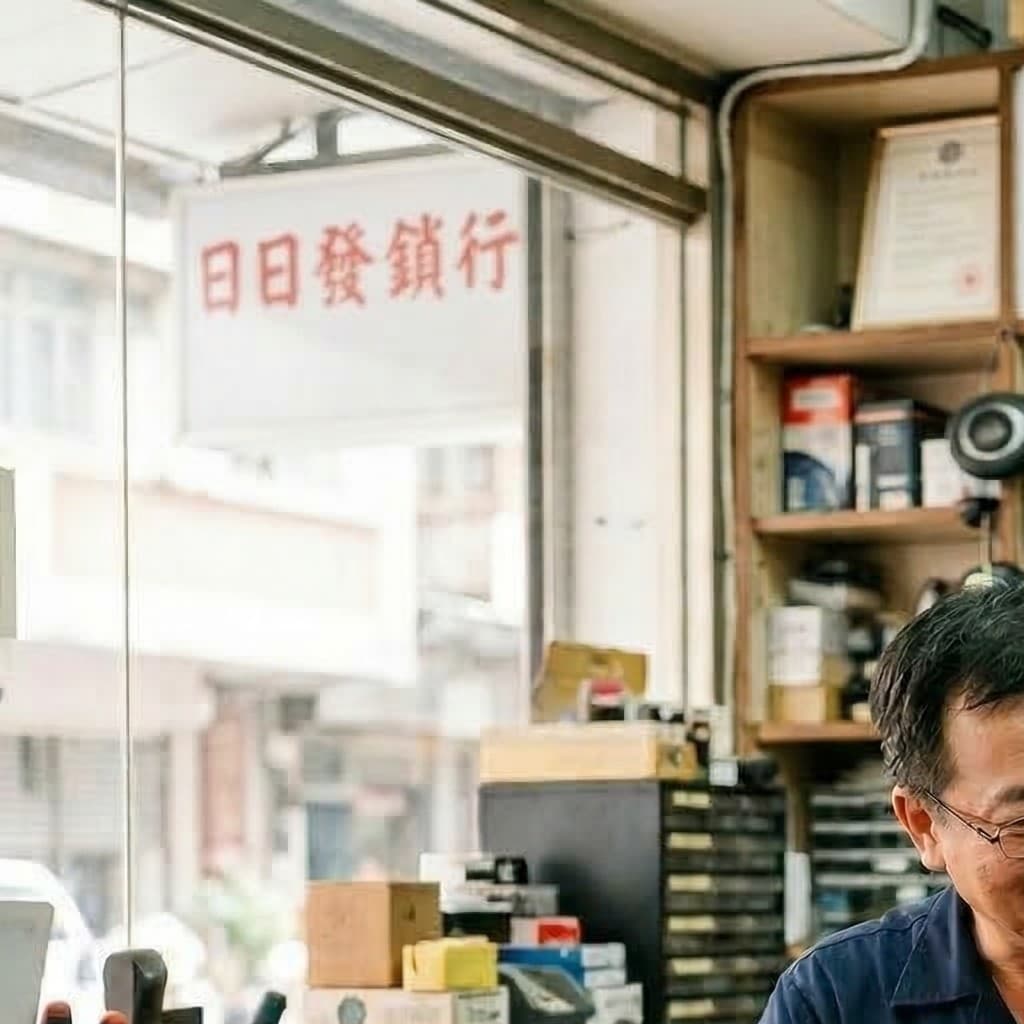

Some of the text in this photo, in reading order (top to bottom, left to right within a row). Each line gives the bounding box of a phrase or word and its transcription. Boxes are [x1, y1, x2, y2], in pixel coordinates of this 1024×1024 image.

[200, 209, 520, 314] 日日發鎖行
